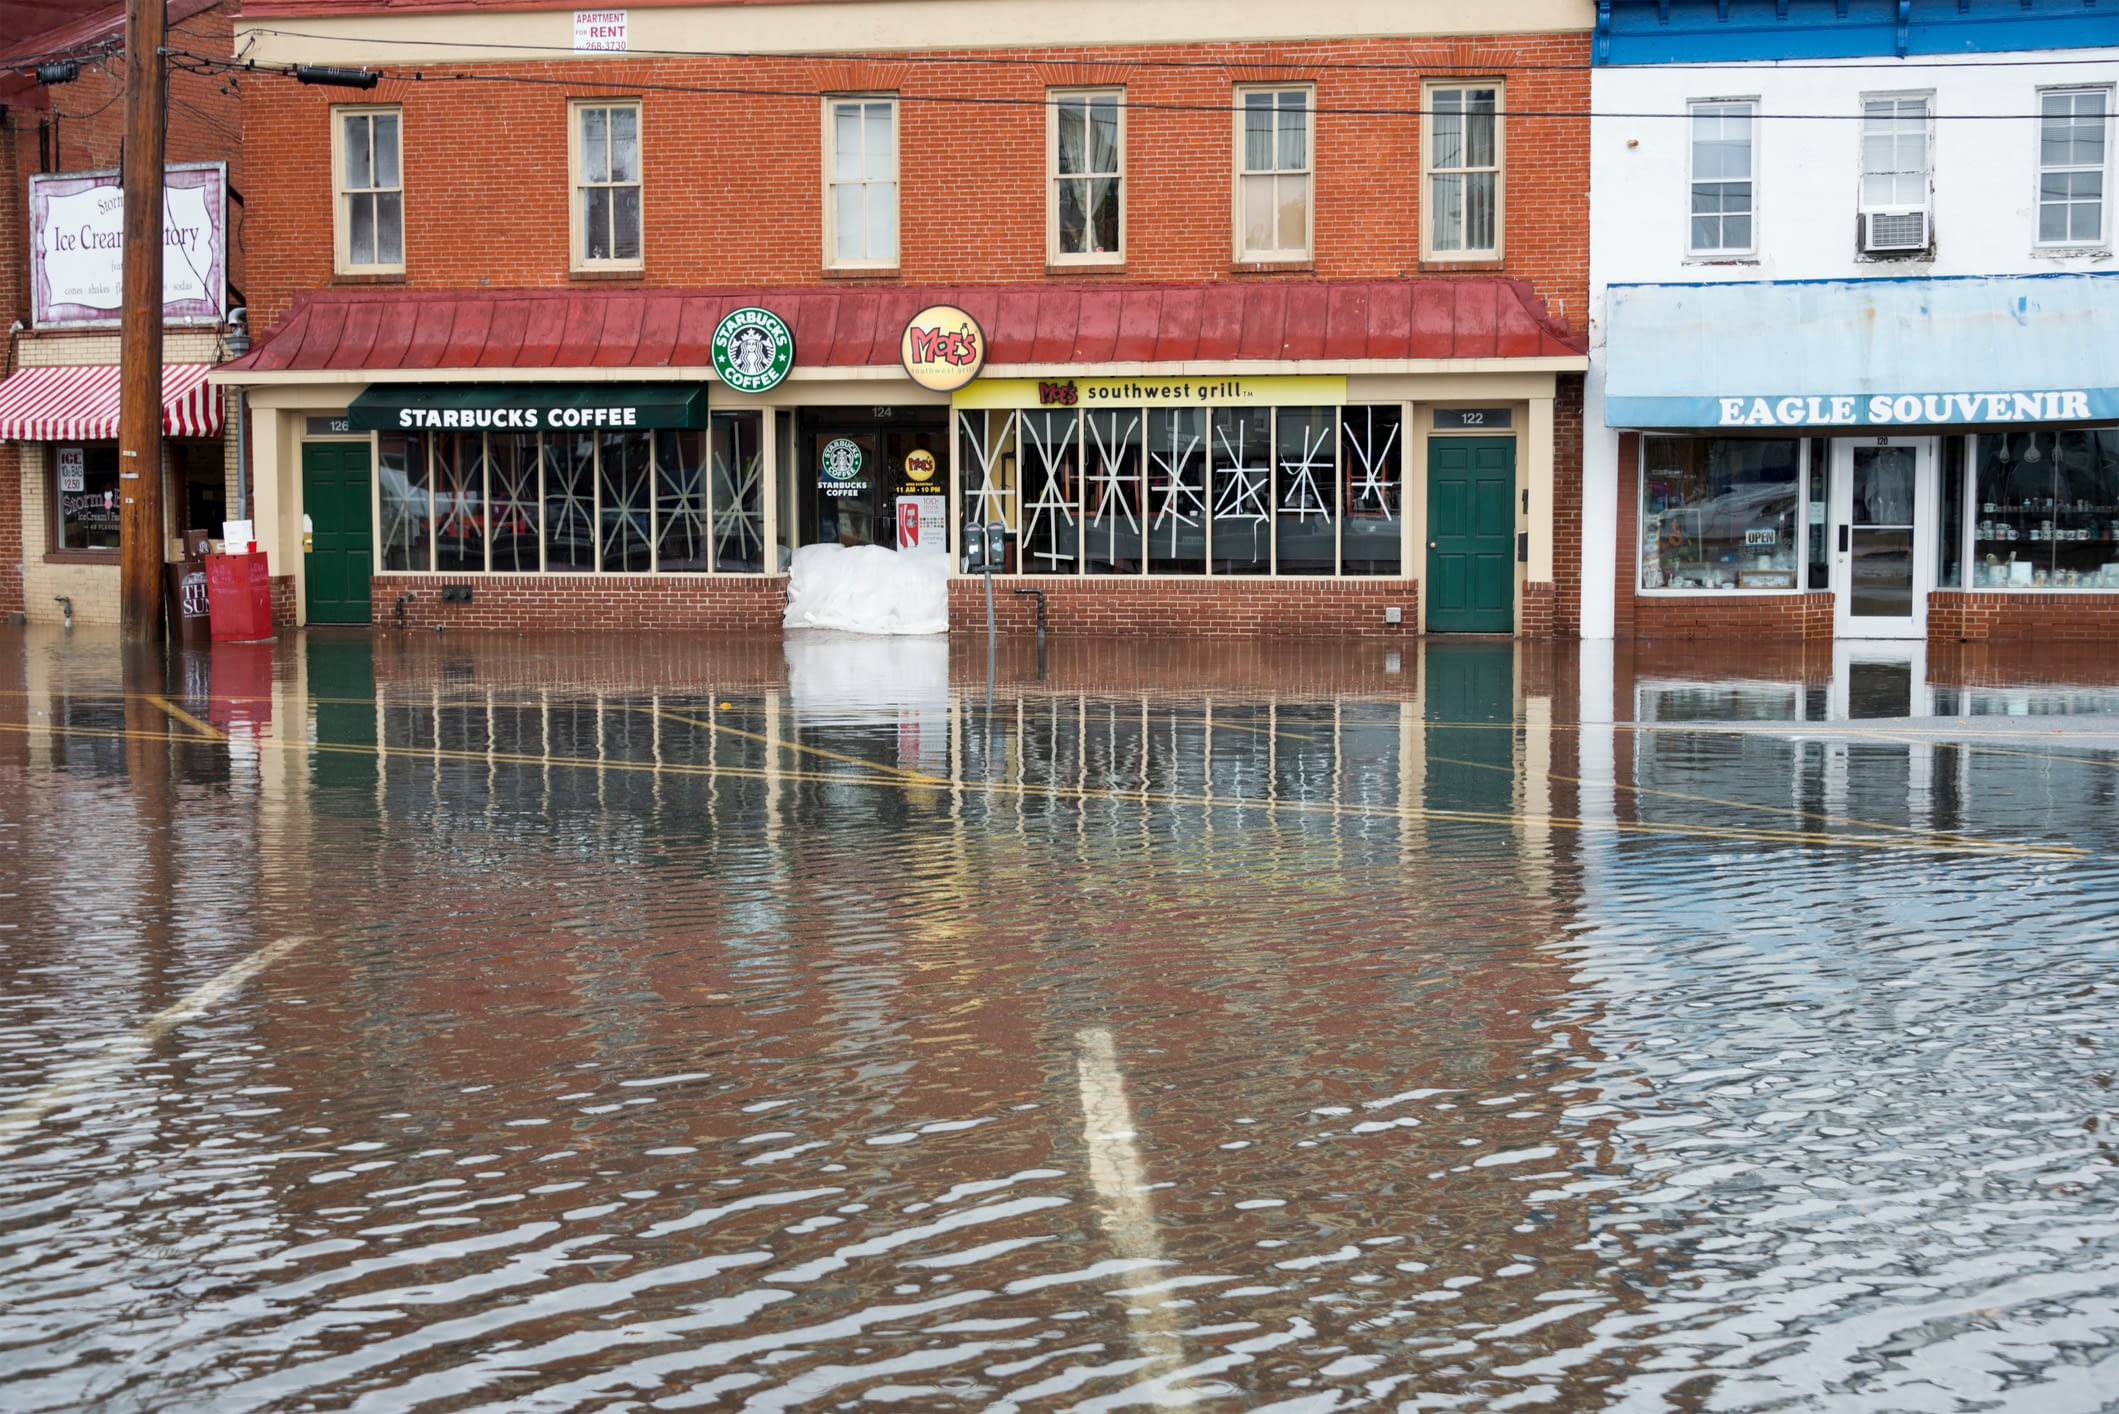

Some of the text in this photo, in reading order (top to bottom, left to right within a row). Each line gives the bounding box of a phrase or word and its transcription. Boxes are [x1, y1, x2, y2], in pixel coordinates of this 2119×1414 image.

[576, 13, 624, 24] APARTMENT
[590, 26, 625, 37] RENT
[586, 41, 627, 50] 268-3730
[54, 226, 76, 252] Ice
[716, 312, 787, 347] STARBUCKS
[911, 365, 976, 376] southwest grill
[724, 367, 780, 389] COFFEE
[1088, 383, 1190, 399] southwest
[1197, 382, 1241, 401] grill
[872, 407, 892, 418] 124
[1719, 391, 2092, 425] EAGLE SOUVENIR
[399, 408, 637, 427] STARBUCKS COFFEE
[1461, 412, 1484, 425] 122
[330, 420, 349, 432] 126
[1876, 436, 1889, 446] 120
[825, 441, 860, 458] STARBUCKS
[61, 453, 82, 465] ICE
[71, 465, 83, 478] BAG
[828, 466, 857, 477] COFFEE
[817, 481, 868, 490] STARBUCKS
[895, 486, 904, 494] 11
[826, 489, 859, 497] COFFEE
[63, 494, 104, 516] Storm
[77, 511, 87, 521] Ice
[87, 511, 107, 521] Cream
[1748, 531, 1774, 544] OPEN
[182, 584, 206, 600] TH
